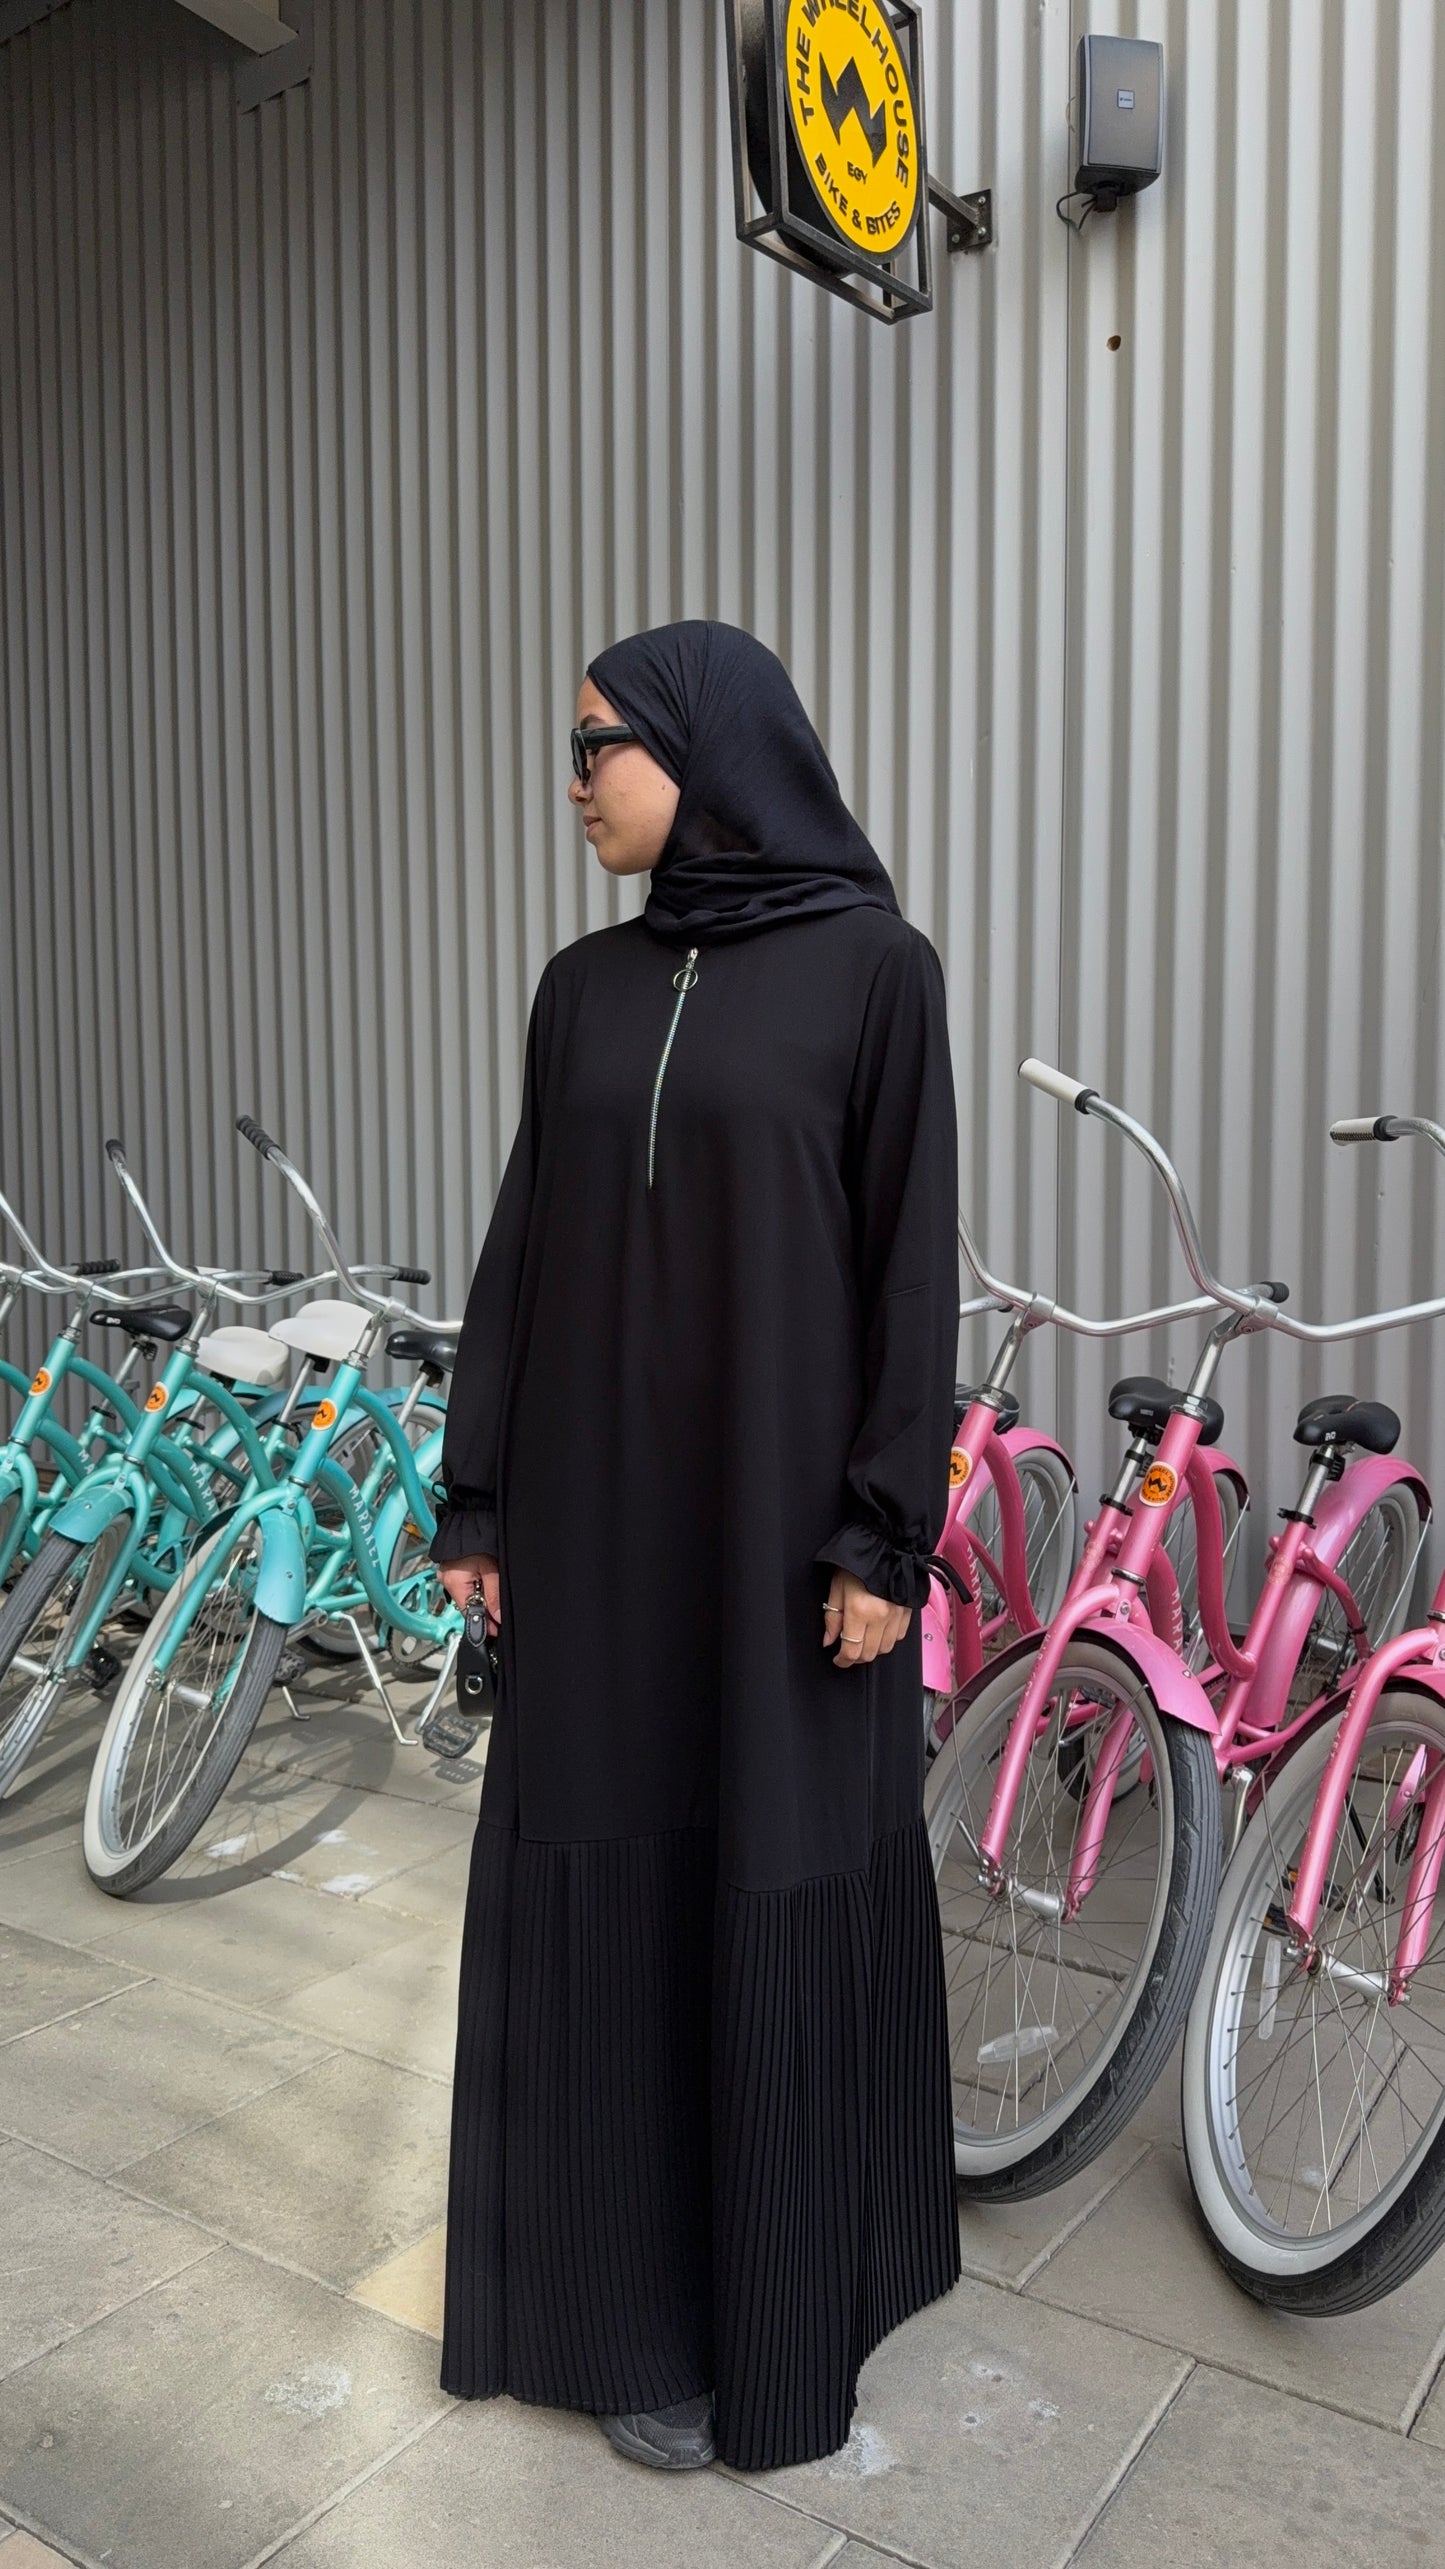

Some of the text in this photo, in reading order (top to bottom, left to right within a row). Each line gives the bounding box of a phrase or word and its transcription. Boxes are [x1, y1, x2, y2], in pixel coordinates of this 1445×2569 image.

[796, 26, 815, 126] THE
[814, 152, 902, 236] BIKE & BITES
[846, 160, 869, 185] EGY
[349, 1484, 380, 1568] MARAKEL
